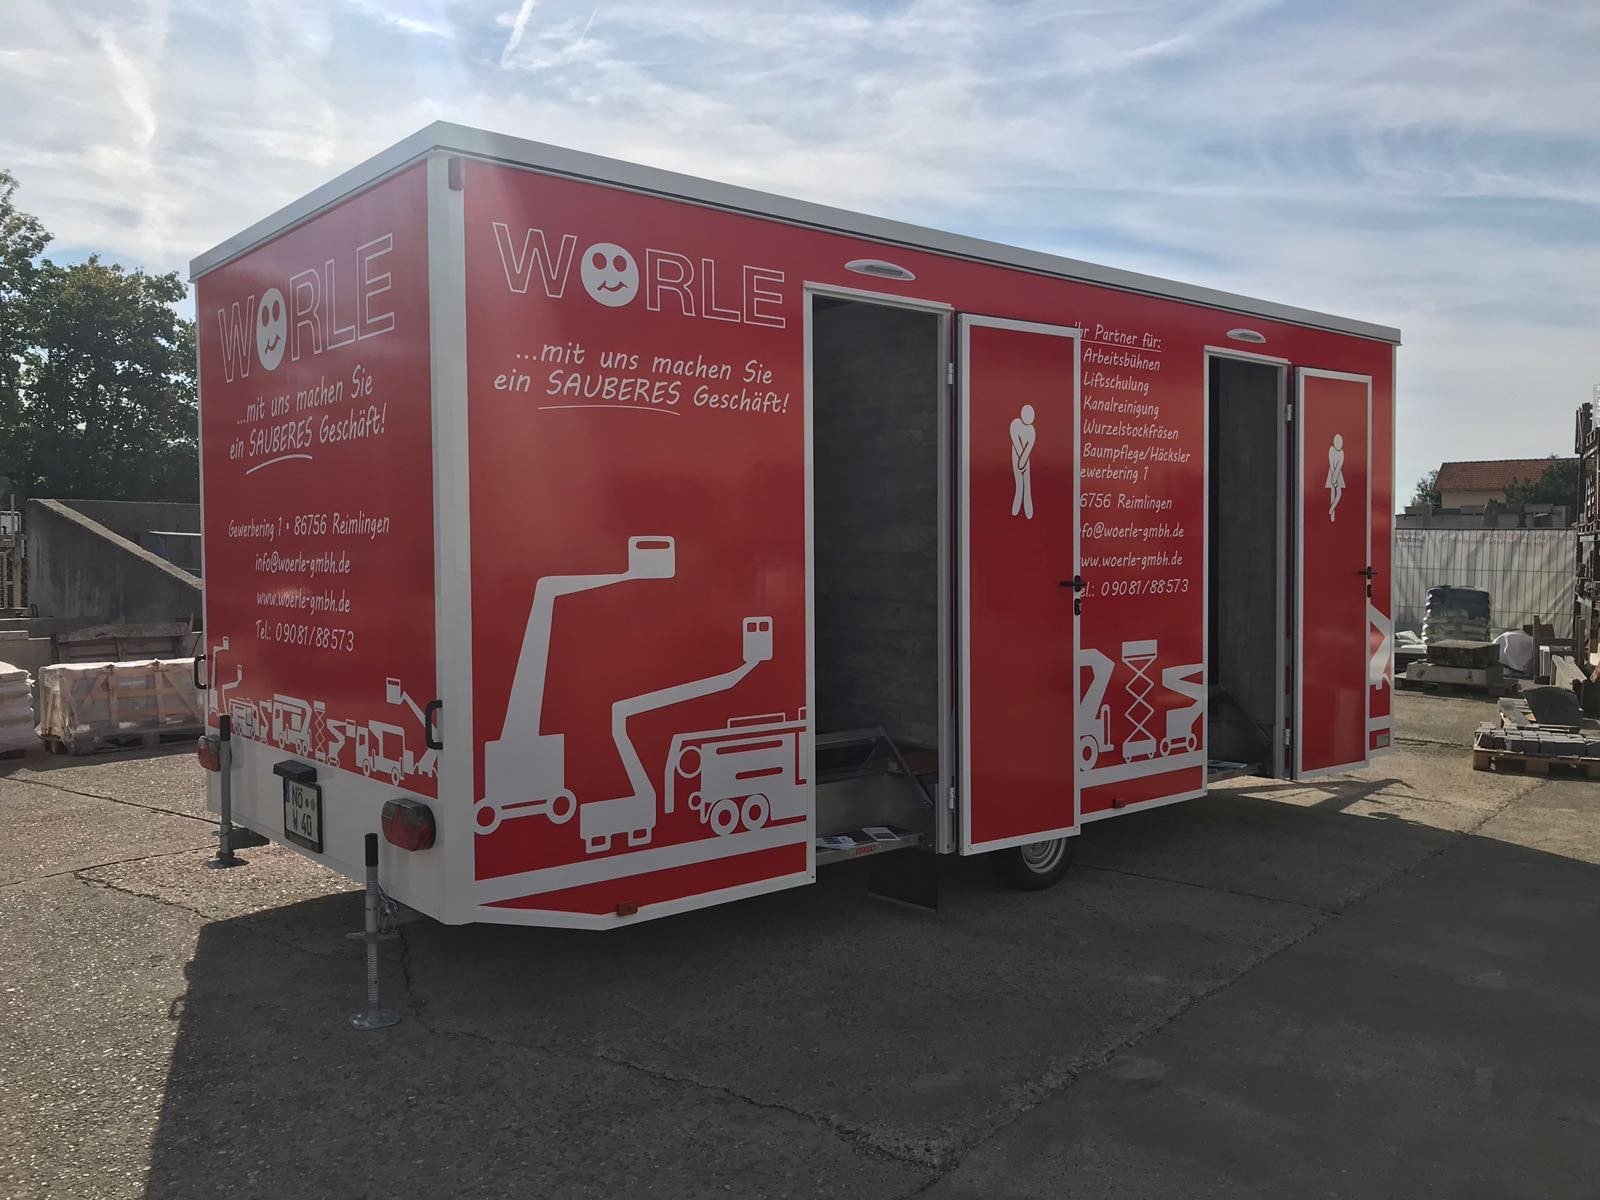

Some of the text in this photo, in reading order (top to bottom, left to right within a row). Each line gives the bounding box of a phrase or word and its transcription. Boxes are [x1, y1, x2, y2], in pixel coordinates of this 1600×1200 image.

[1095, 323, 1137, 345] Partner
[1142, 332, 1161, 349] für:
[600, 351, 638, 370] uns
[652, 355, 731, 380] machen
[743, 360, 772, 384] Sie
[1083, 347, 1161, 371] Arbeitsbühnen
[271, 394, 290, 417] uns
[296, 376, 343, 411] machen
[351, 364, 373, 398] Sie
[494, 368, 790, 414] ein SAUBERES Geschäft!
[1083, 371, 1149, 396] Liftschulung
[1083, 395, 1159, 420] Kanalreinigung
[229, 402, 387, 460] ein SAUBERES Geschäft!
[1083, 419, 1179, 440] Wurzelstockfräsen
[1083, 442, 1191, 464] Baumpflege/Häcksler
[1080, 464, 1149, 484] ewerbering 1
[1080, 493, 1172, 513] 6756 Reimlingen
[228, 510, 390, 542] Gewerbering 1 86756 Reimlingen
[256, 551, 350, 578] info@woerle-gmbh.de
[1080, 550, 1183, 570] ww.woerle-gmbh.de
[1080, 579, 1189, 598] el.: 09081/88573
[256, 588, 350, 615] www.woerle-gmbh.de
[256, 619, 354, 652] Tel.: 09081/88573
[292, 785, 303, 809] NÖ
[302, 813, 312, 837] 40
